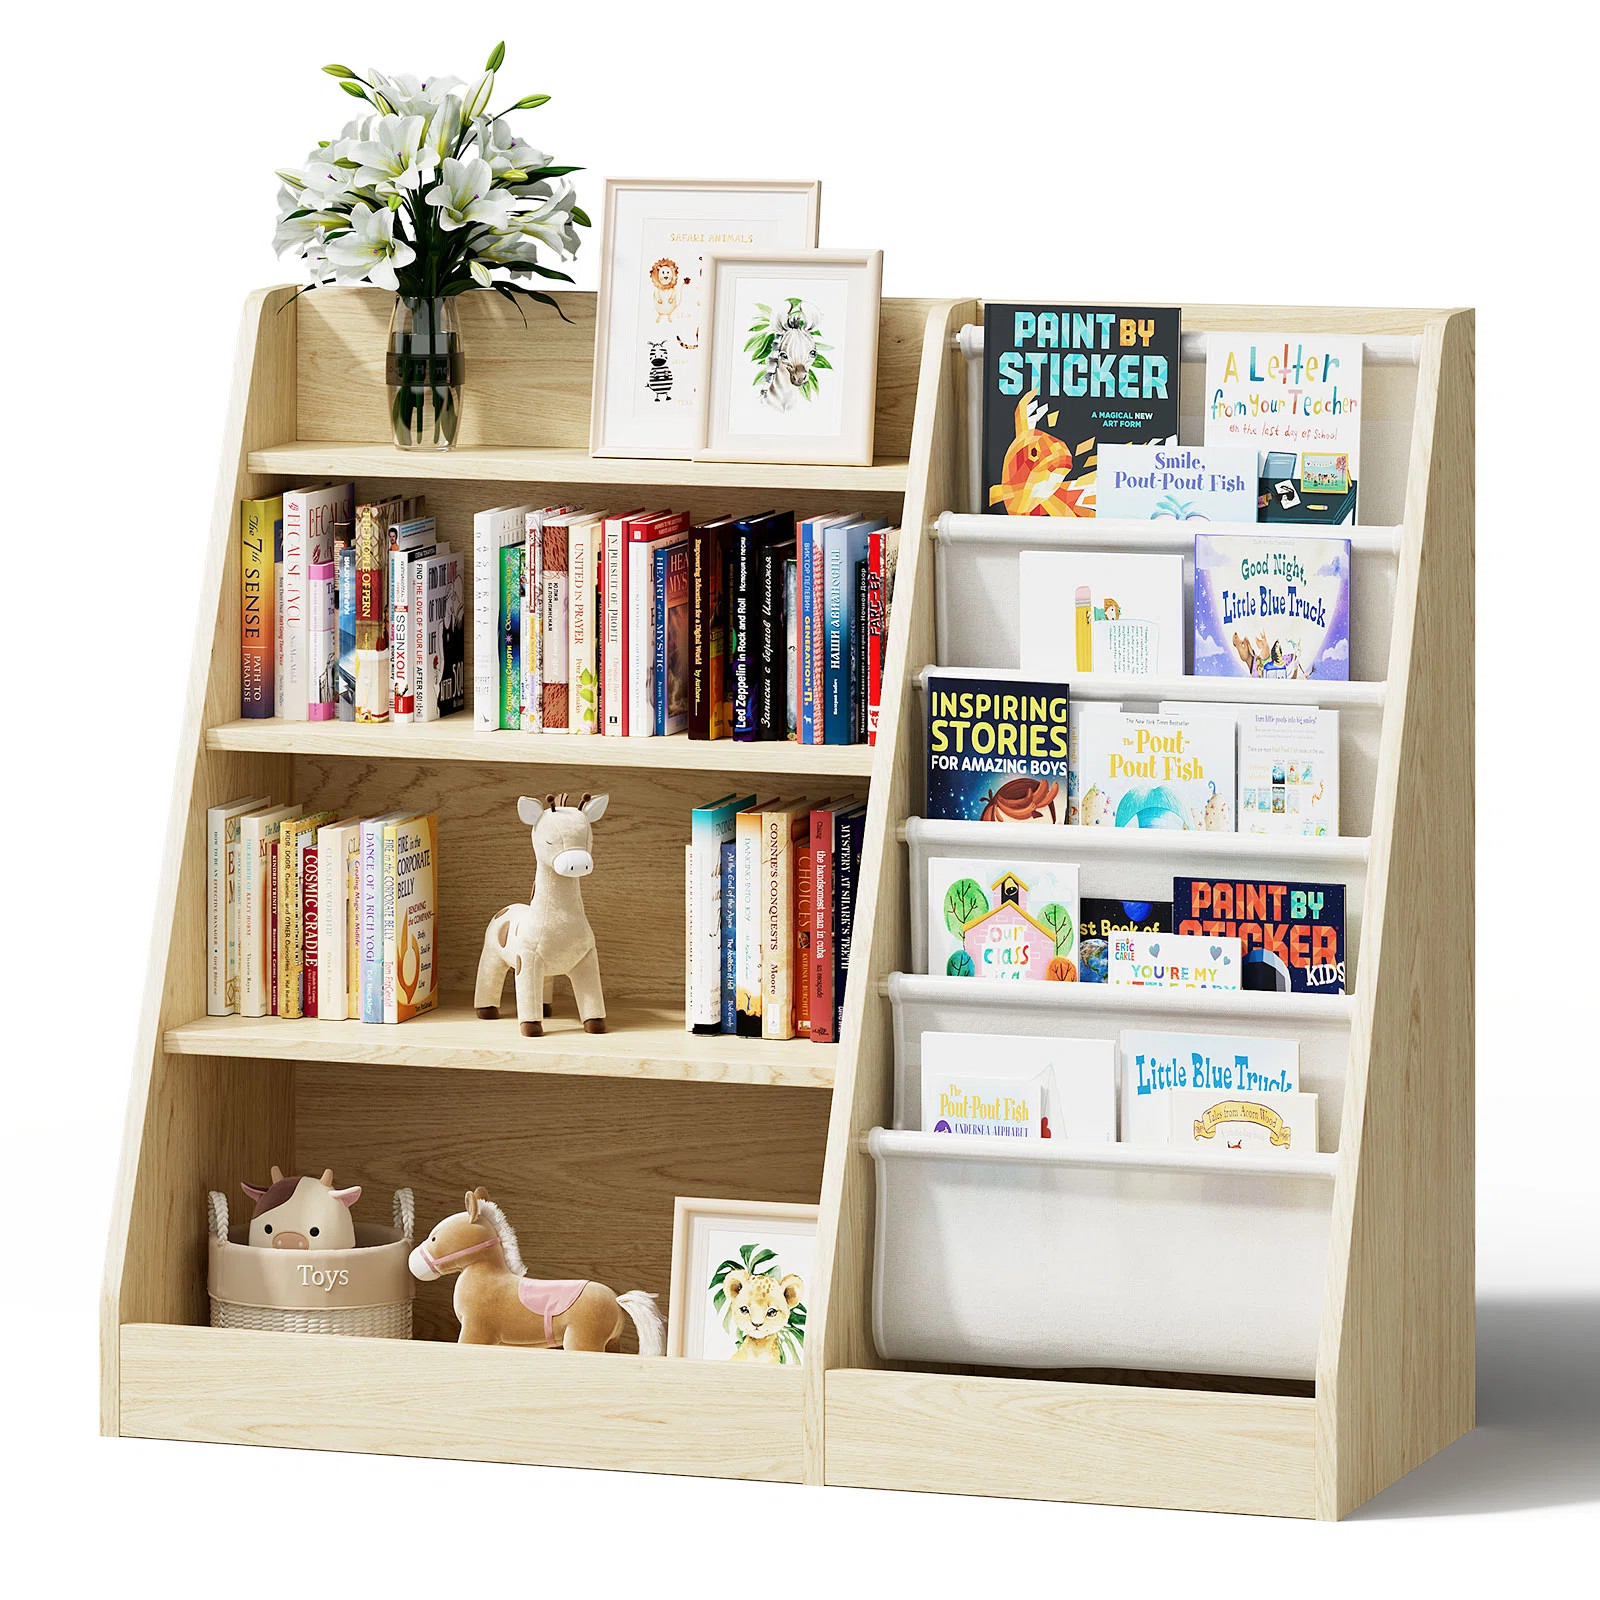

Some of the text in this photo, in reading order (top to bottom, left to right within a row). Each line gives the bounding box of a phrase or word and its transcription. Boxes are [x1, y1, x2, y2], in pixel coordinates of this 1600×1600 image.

[669, 233, 754, 244] SAFARI ANIMALS
[1014, 311, 1155, 350] PAINT BY
[998, 351, 1169, 400] STICKER
[1223, 343, 1340, 385] A Letter
[1099, 411, 1133, 420] MAGICAL
[1134, 412, 1153, 421] NEW
[1211, 389, 1358, 424] from your Teacher
[1102, 419, 1142, 428] ART FORM
[1154, 451, 1206, 472] Smile,
[1114, 470, 1246, 493] Pout-Pout Fish
[243, 515, 263, 638] The 7th SENSE
[362, 511, 371, 617] THE PEOPLE OF PERN
[656, 556, 664, 602] HEART
[1241, 553, 1308, 586] Good Night,
[574, 543, 584, 645] UNITED IN PRAYER
[608, 534, 618, 643] IN PURSUIT OF PROFIT
[761, 556, 772, 616] Имоложья
[656, 611, 664, 620] the
[736, 598, 746, 614] Roll
[830, 549, 842, 669] НАШИ АВИАНОСЦЫ
[1222, 585, 1326, 628] Little Blue Truck
[416, 563, 424, 702] FIND THE LOVE OF YOUR LIFE AFTER 50!
[736, 615, 746, 630] and
[656, 624, 664, 672] MYSTIC
[736, 632, 746, 652] Rock
[761, 619, 772, 663] берегов
[244, 653, 252, 703] PARADISE
[253, 655, 262, 702] PATH TO
[736, 664, 746, 707] Zeppelin
[736, 709, 746, 728] Led
[761, 679, 772, 728] Записки
[931, 691, 1067, 723] INSPIRING
[931, 719, 1068, 759] STORIES
[1123, 728, 1190, 755] The Pout-
[931, 755, 1068, 777] FOR AMAZING BOYS
[1108, 753, 1204, 782] Pout Fish
[366, 833, 375, 870] DANCE
[384, 839, 394, 852] FIRE
[353, 860, 361, 890] Creating
[384, 863, 394, 873] the
[397, 849, 431, 876] CORPORATE
[366, 874, 375, 890] OF
[384, 875, 394, 917] CORPORATE
[397, 877, 415, 899] BELLY
[726, 852, 735, 928] At the End of the Ages
[798, 855, 811, 927] CHOICES
[841, 824, 850, 969] MYSTERY AT SHARK'S TEETH
[305, 855, 318, 966] COSMIC CRADLE
[353, 891, 361, 912] Magic
[769, 823, 778, 994] CONNIE'S CONQUESTS Moore
[816, 850, 826, 958] the handsomest man in cuba
[1191, 881, 1324, 922] PAINT BY
[366, 904, 375, 930] RICH
[384, 919, 394, 941] BELLY
[353, 922, 361, 947] Midlife
[366, 934, 375, 962] YOGI
[988, 926, 1025, 943] our
[984, 945, 1030, 965] class
[1115, 951, 1135, 961] CARLE
[1131, 964, 1218, 982] YOU'RE MY
[1304, 960, 1345, 987] KIDS
[1135, 1052, 1293, 1096] Little Blue Truck
[949, 1084, 962, 1097] The
[939, 1093, 1030, 1123] Pout-Pout Fish
[1206, 1105, 1278, 1128] Tales from Acorn Wood
[955, 1123, 1029, 1138] UNDERSEA ALPHABET
[297, 1264, 350, 1293] Toys
